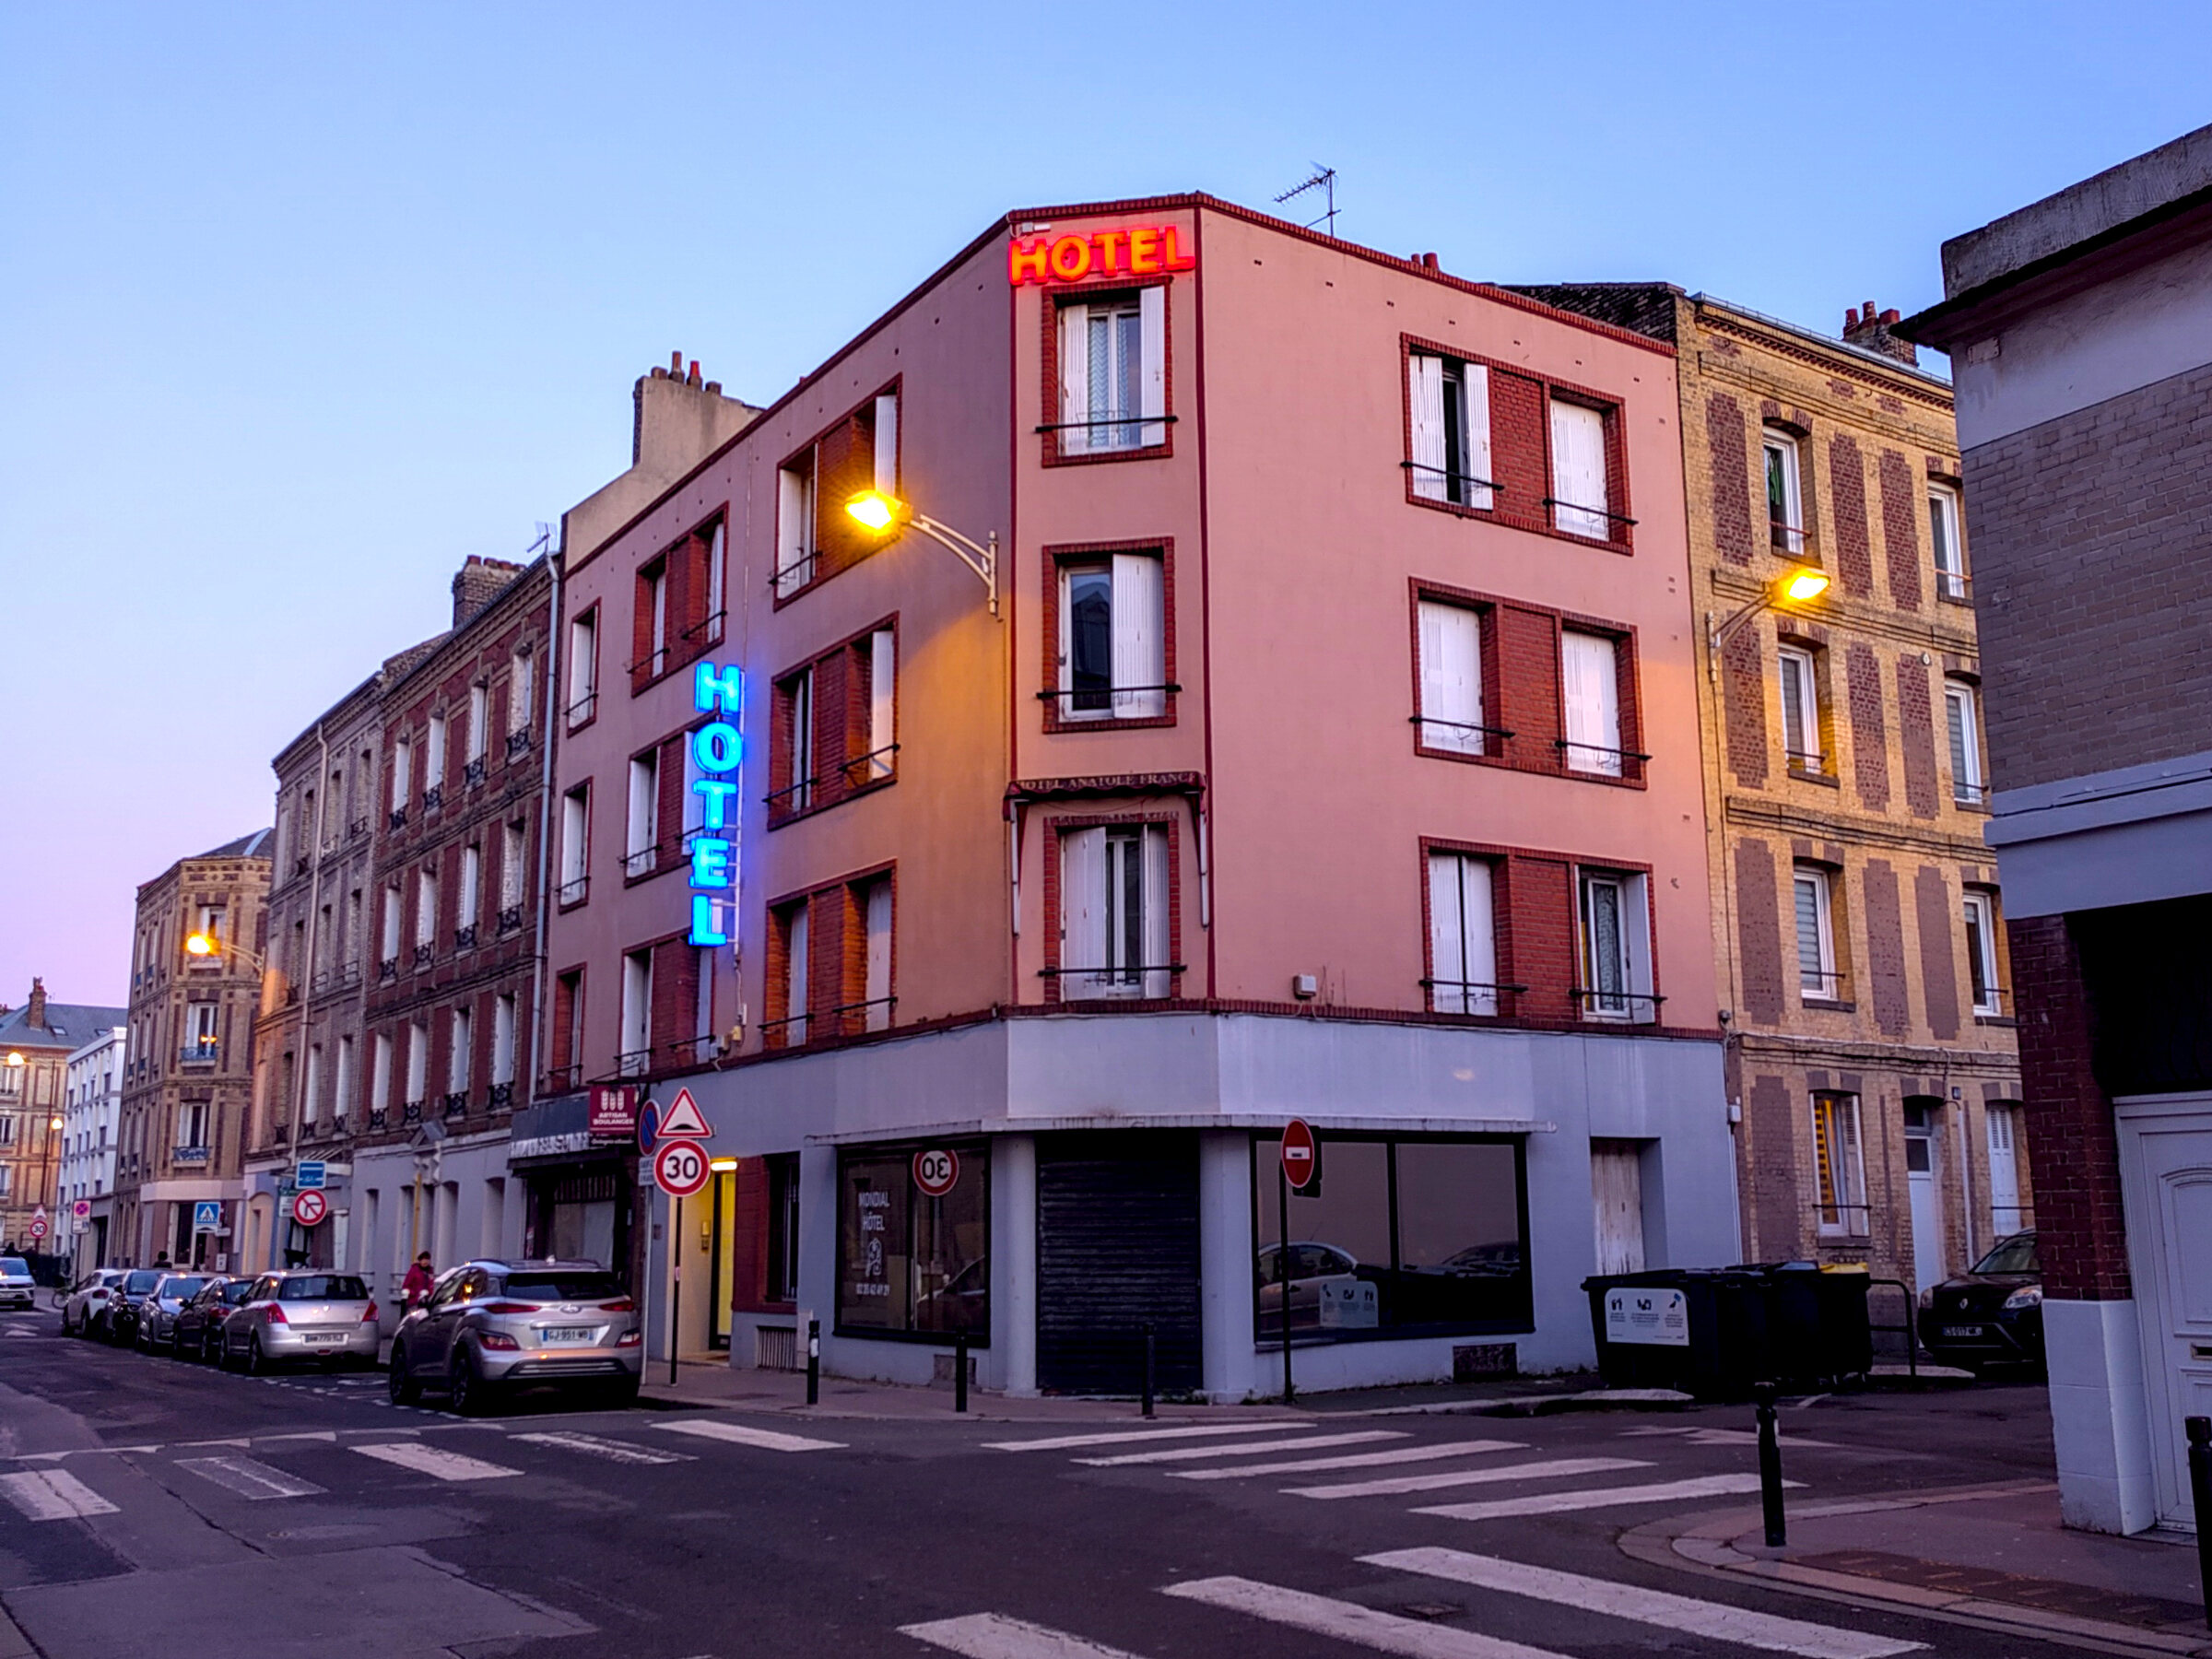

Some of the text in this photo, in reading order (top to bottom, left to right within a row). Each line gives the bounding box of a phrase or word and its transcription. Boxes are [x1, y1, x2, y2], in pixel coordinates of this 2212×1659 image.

[1009, 226, 1195, 285] HOTEL
[1069, 775, 1135, 788] ANATOLE
[688, 662, 743, 947] HOTEL
[666, 1156, 699, 1179] 30
[33, 1225, 44, 1233] 30
